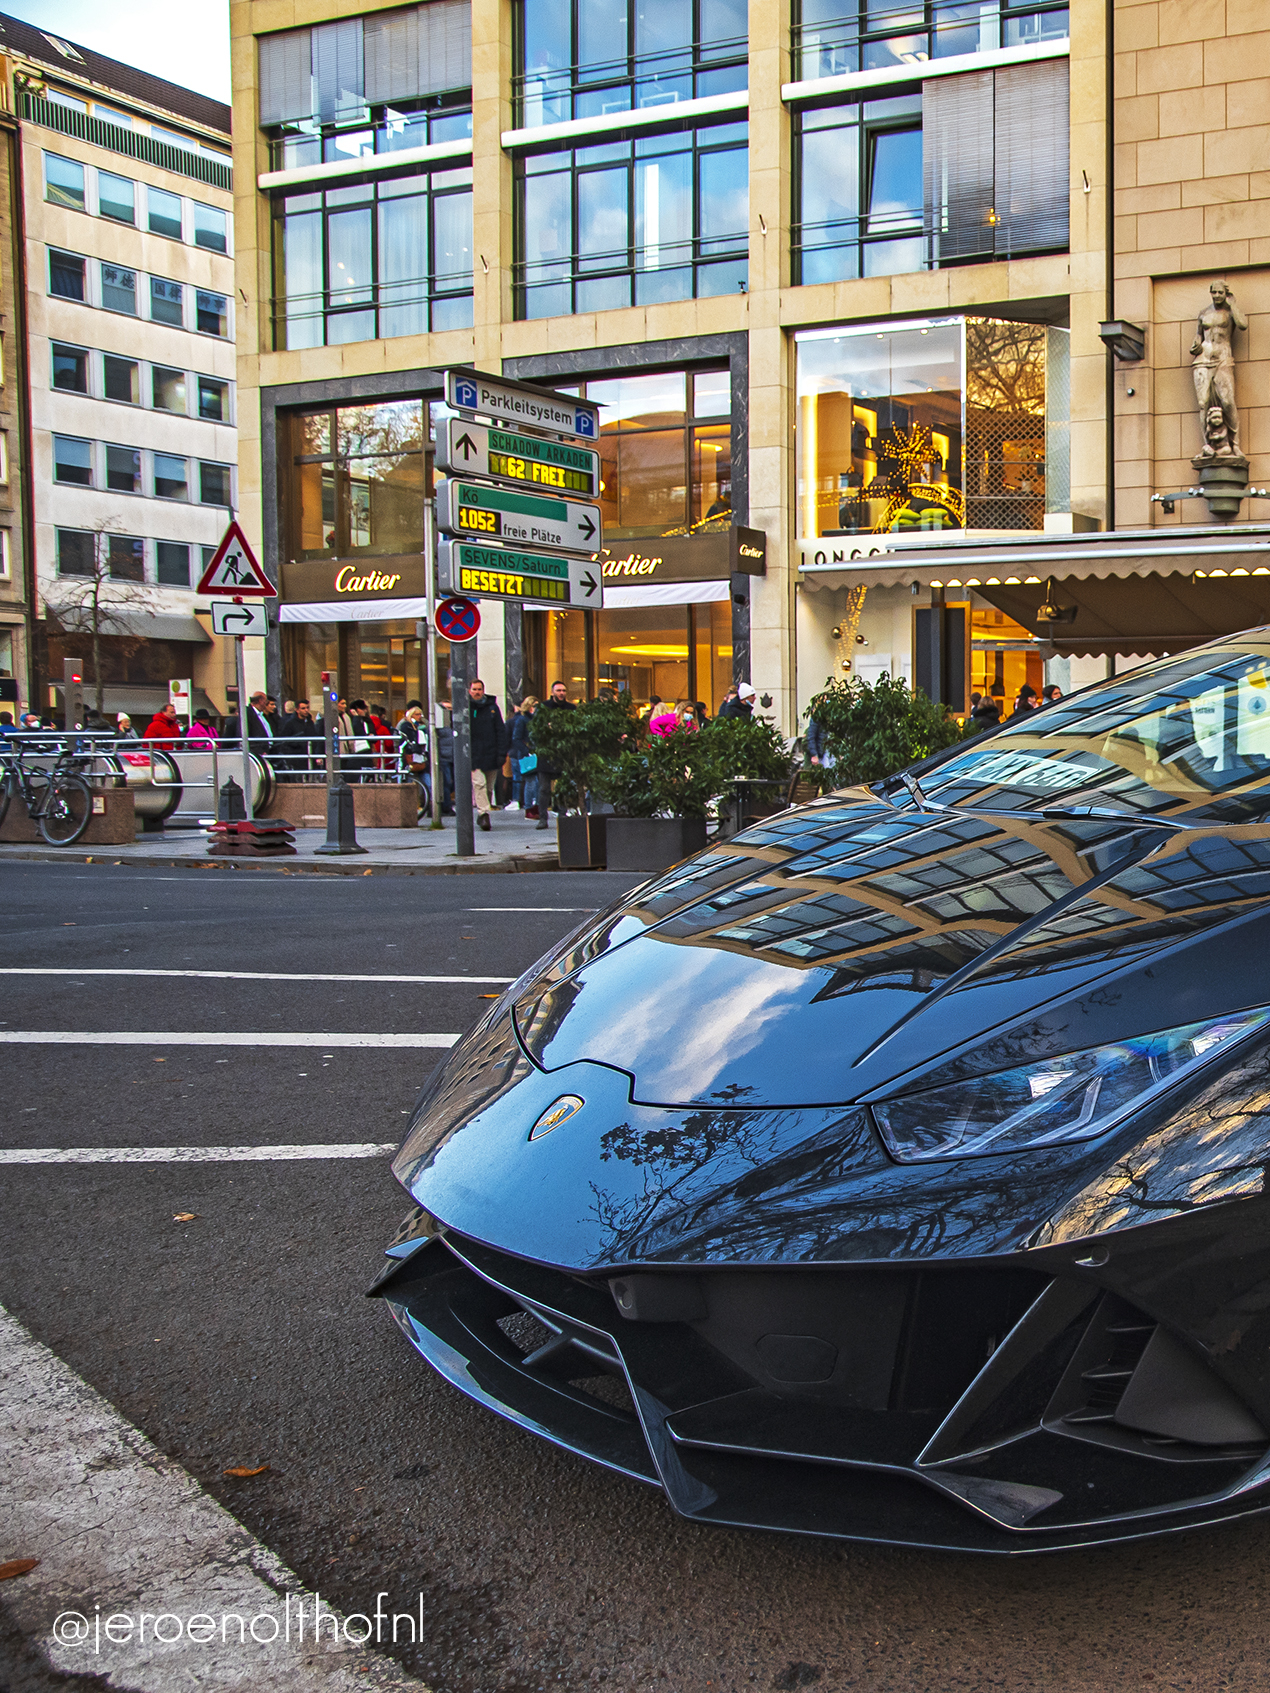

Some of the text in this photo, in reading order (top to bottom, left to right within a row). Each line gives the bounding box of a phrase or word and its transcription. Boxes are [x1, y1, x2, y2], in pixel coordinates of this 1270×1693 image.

[481, 389, 572, 425] Parkleitsystem
[492, 433, 591, 469] SCHADOW ARKADEN
[507, 457, 566, 488] 62 FREI
[462, 488, 479, 503] Kö
[459, 507, 496, 532] 1052
[503, 524, 562, 544] freie Plätze
[464, 549, 561, 575] SEVENS/Saturn
[739, 543, 764, 559] Cartier
[334, 565, 401, 593] Cartier
[461, 568, 524, 595] BESETZT
